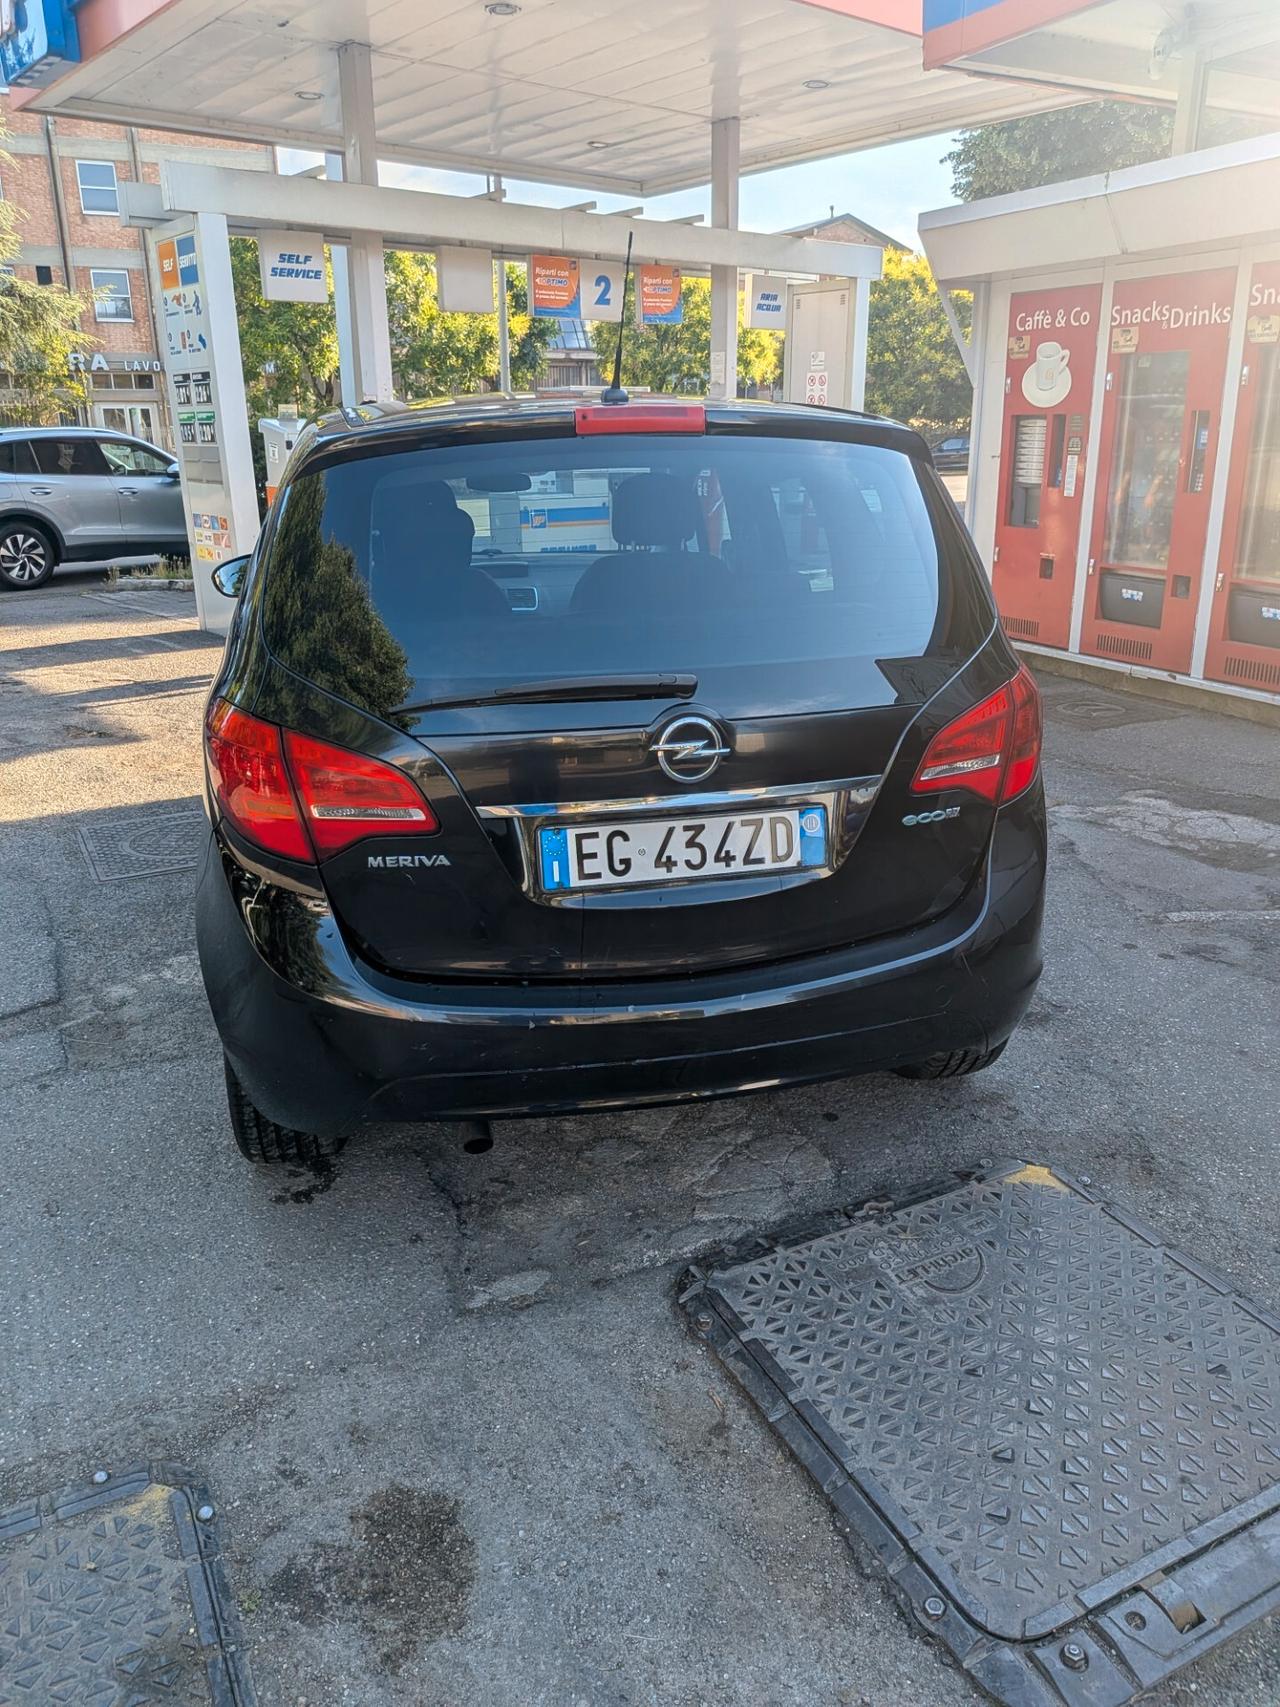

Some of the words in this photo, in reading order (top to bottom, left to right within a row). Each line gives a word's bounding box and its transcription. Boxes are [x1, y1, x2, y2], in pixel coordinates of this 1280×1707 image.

[278, 253, 313, 265] SELF
[270, 266, 323, 280] SERVICE
[594, 274, 612, 306] 2
[760, 293, 778, 302] ARIA
[756, 303, 782, 312] ACQUA
[1016, 310, 1051, 331] Caffè
[1055, 309, 1068, 328] &
[1070, 307, 1091, 326] Co
[1111, 301, 1170, 326] Snacks
[1170, 302, 1231, 329] Drinks
[575, 830, 632, 881] EG
[654, 816, 794, 874] 434ZD
[367, 854, 451, 868] MERIVA
